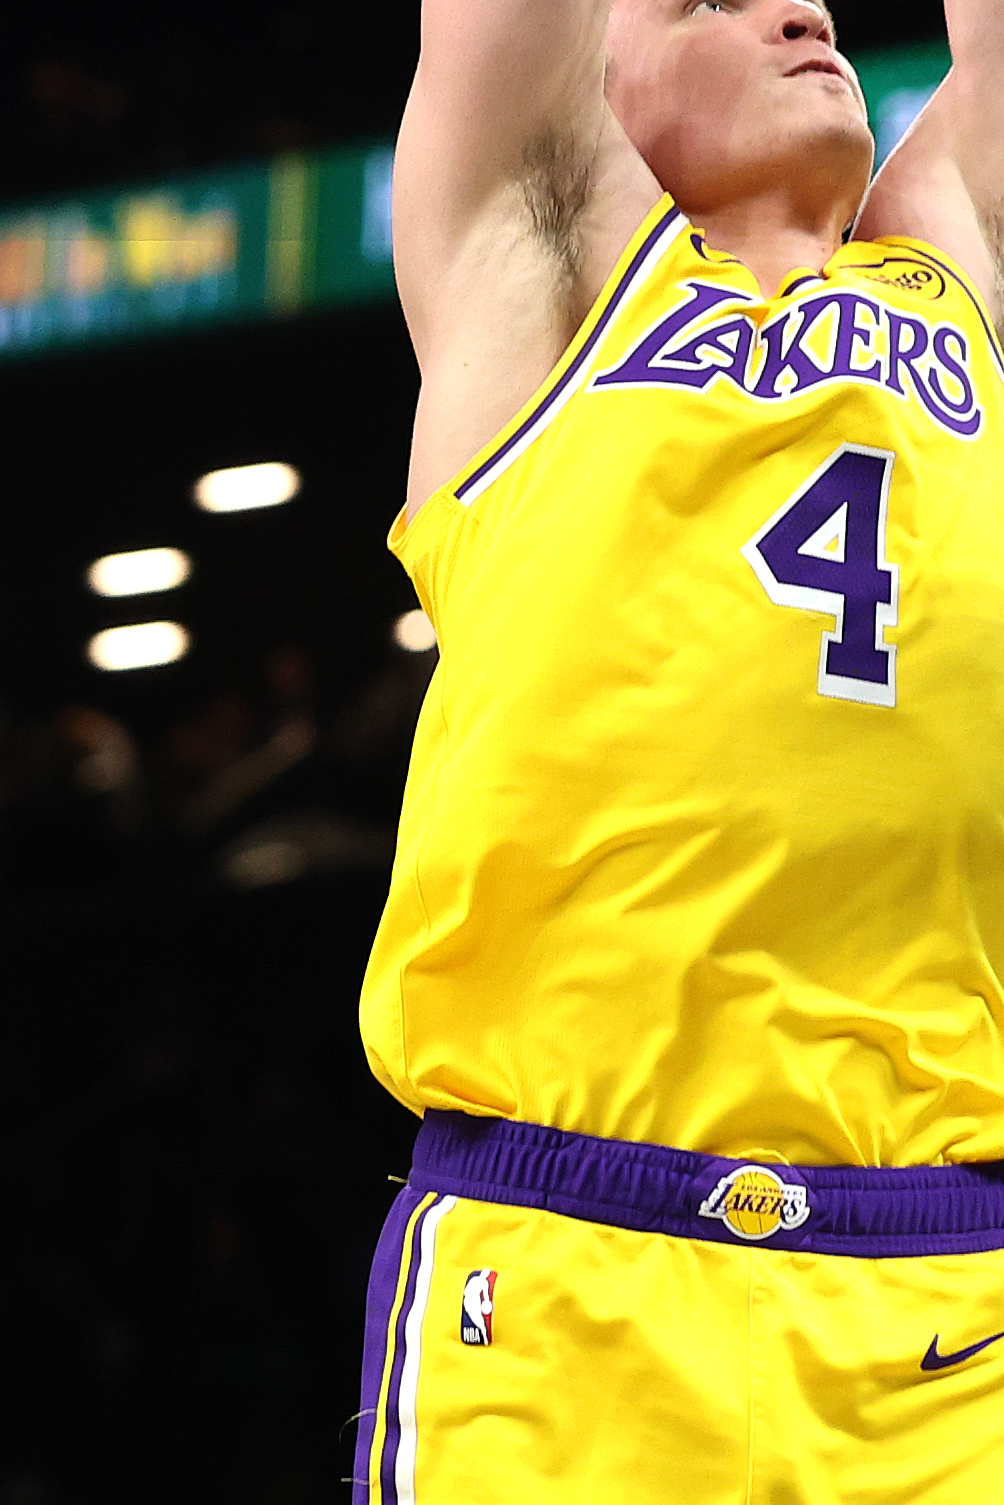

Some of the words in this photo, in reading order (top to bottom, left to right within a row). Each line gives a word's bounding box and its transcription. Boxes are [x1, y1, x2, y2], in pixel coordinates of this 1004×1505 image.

[590, 282, 983, 438] LAKERS
[741, 443, 899, 707] 4
[707, 1183, 806, 1225] LAKERS
[463, 1326, 480, 1343] NBA
